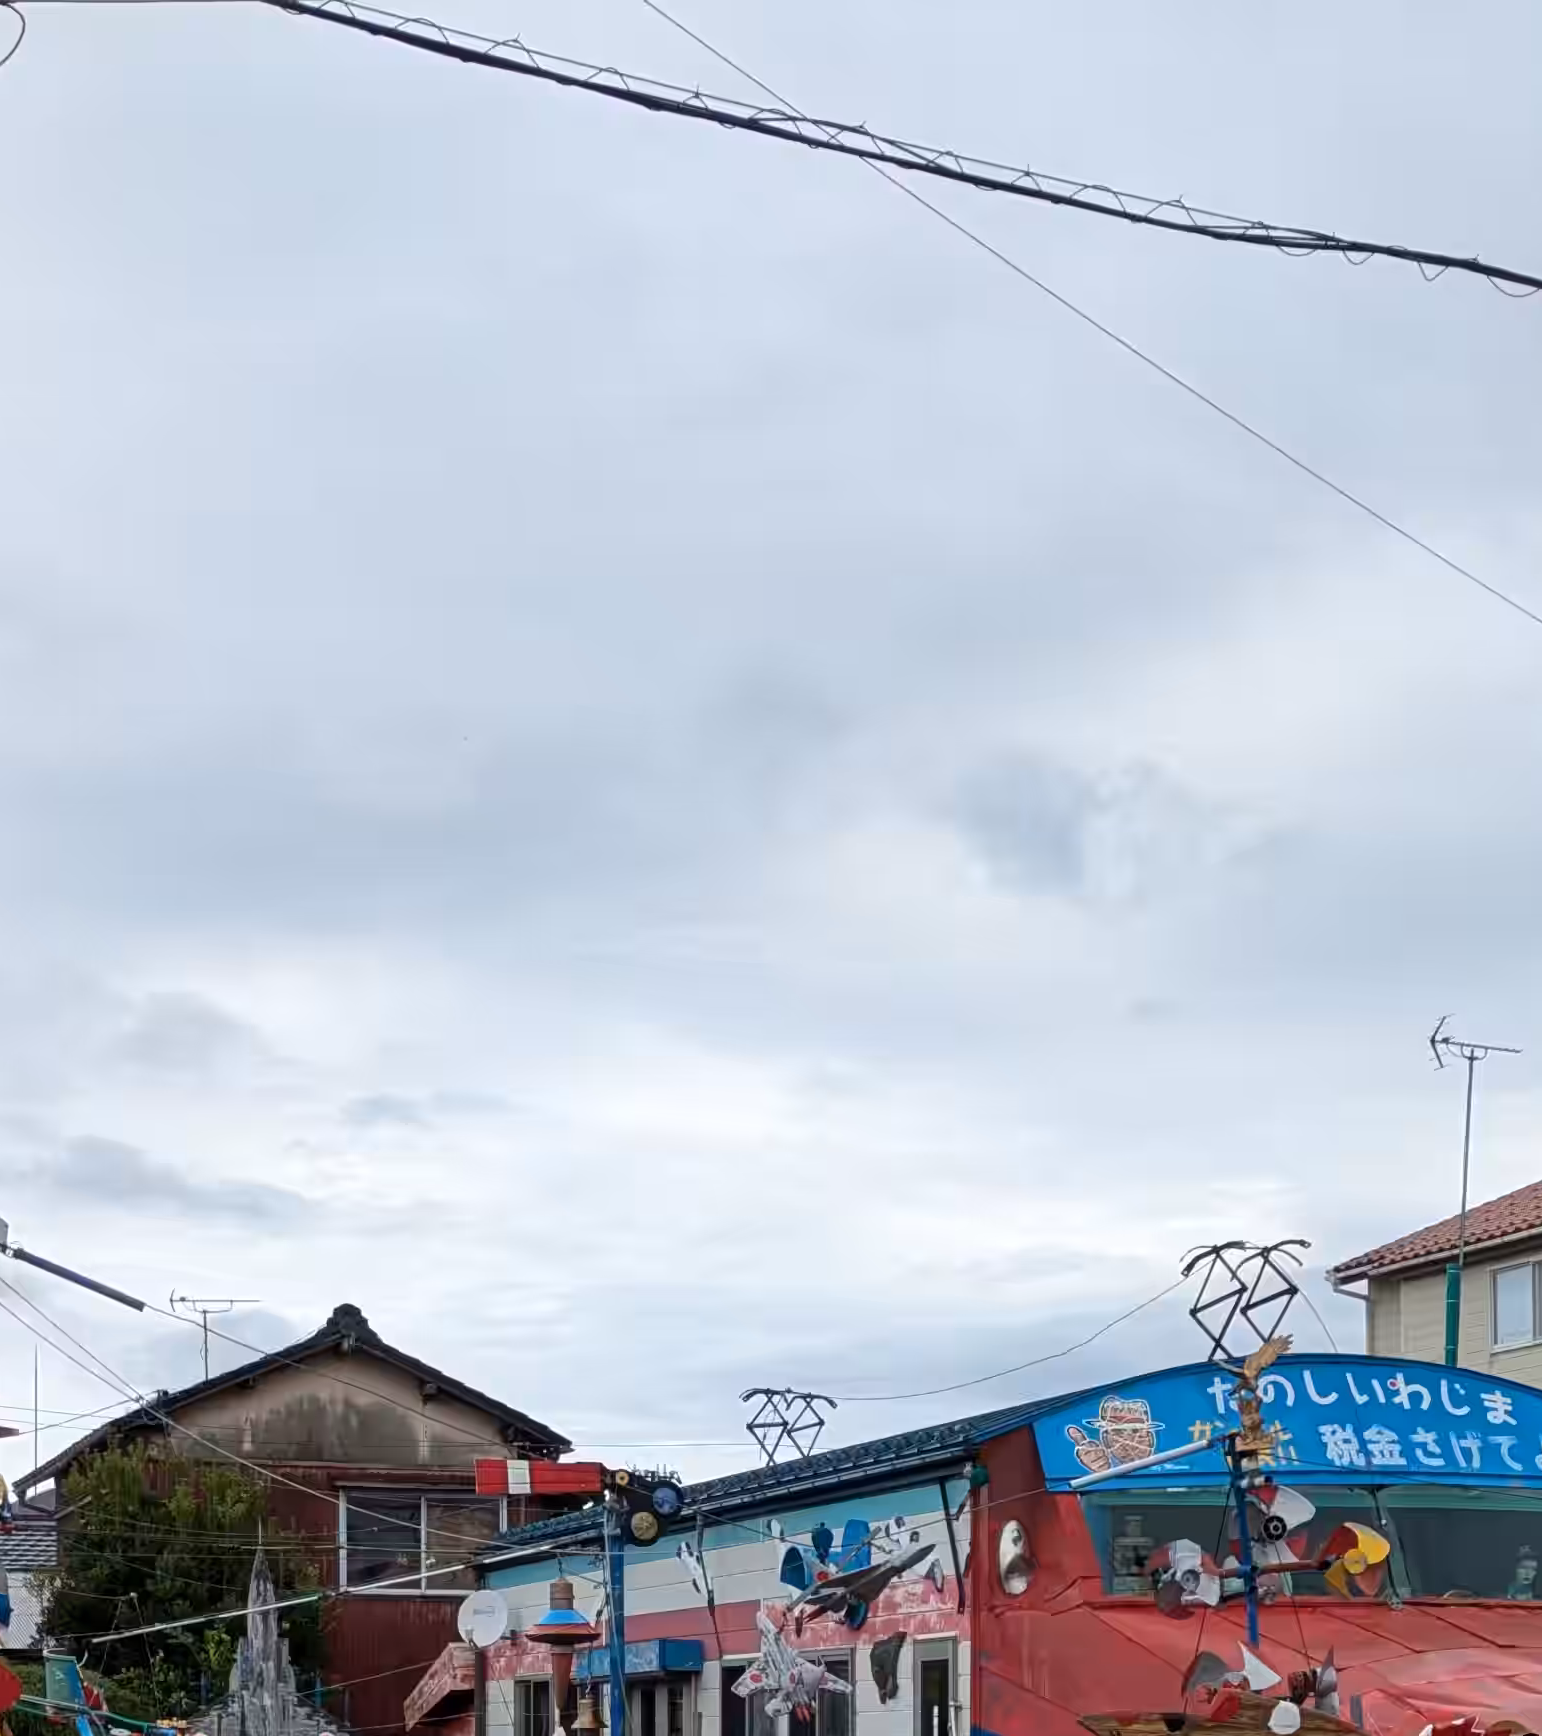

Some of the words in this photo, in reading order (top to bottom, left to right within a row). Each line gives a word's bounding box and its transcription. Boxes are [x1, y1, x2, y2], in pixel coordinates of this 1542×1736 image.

[1207, 1370, 1518, 1425] たのしいわじま
